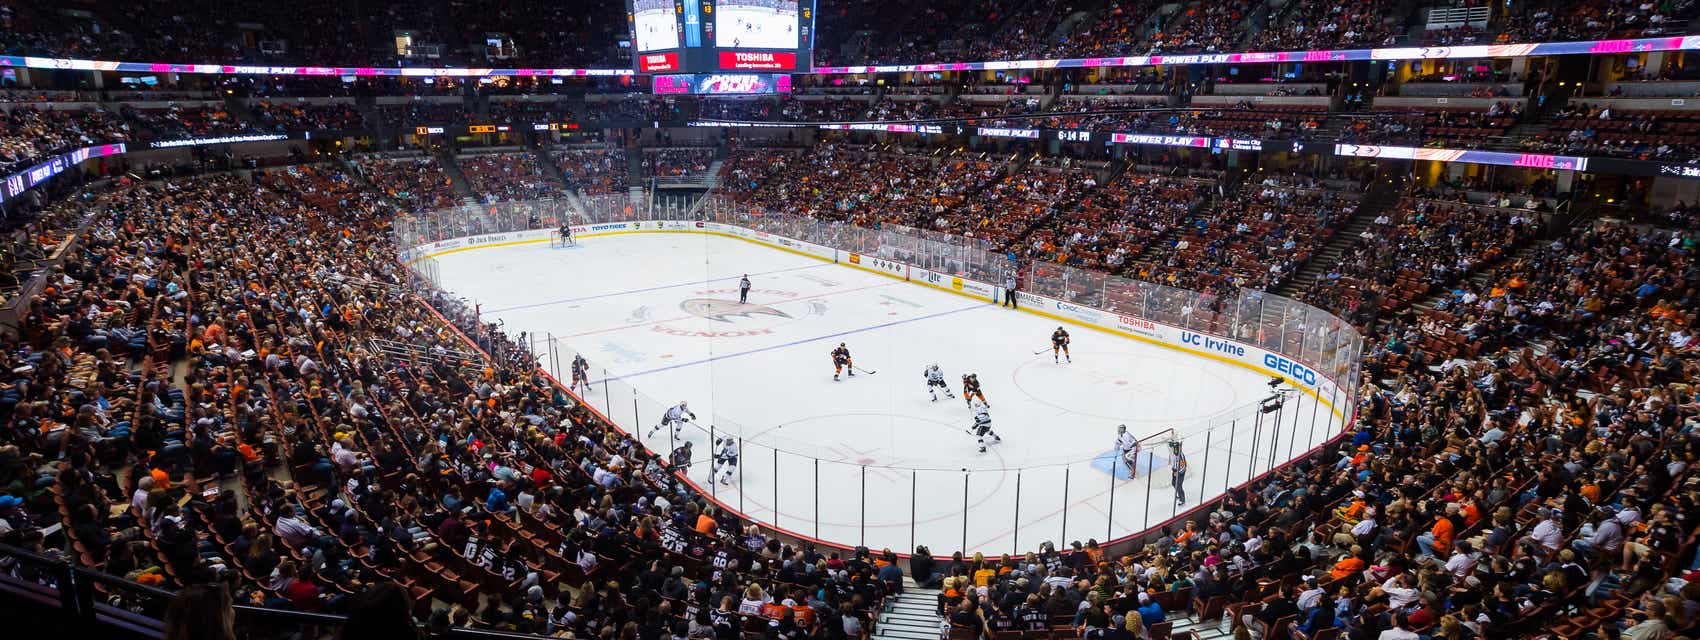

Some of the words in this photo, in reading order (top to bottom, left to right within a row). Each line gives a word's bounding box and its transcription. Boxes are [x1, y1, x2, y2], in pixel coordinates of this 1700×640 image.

[735, 53, 774, 62] TOSHIBA
[1161, 55, 1199, 64] POWER
[1201, 54, 1229, 63] PLAY
[982, 128, 1010, 137] POWER
[1011, 129, 1034, 137] PLAY
[1058, 132, 1077, 141] 6:14
[1079, 132, 1090, 141] PM
[1125, 135, 1163, 144] POWER
[1164, 136, 1194, 146] PLAY
[1513, 154, 1554, 169] JMG
[1119, 315, 1155, 330] TOSHIBA
[1181, 331, 1200, 346] UC
[1205, 336, 1245, 356] Irvine
[1263, 352, 1316, 386] GEICO
